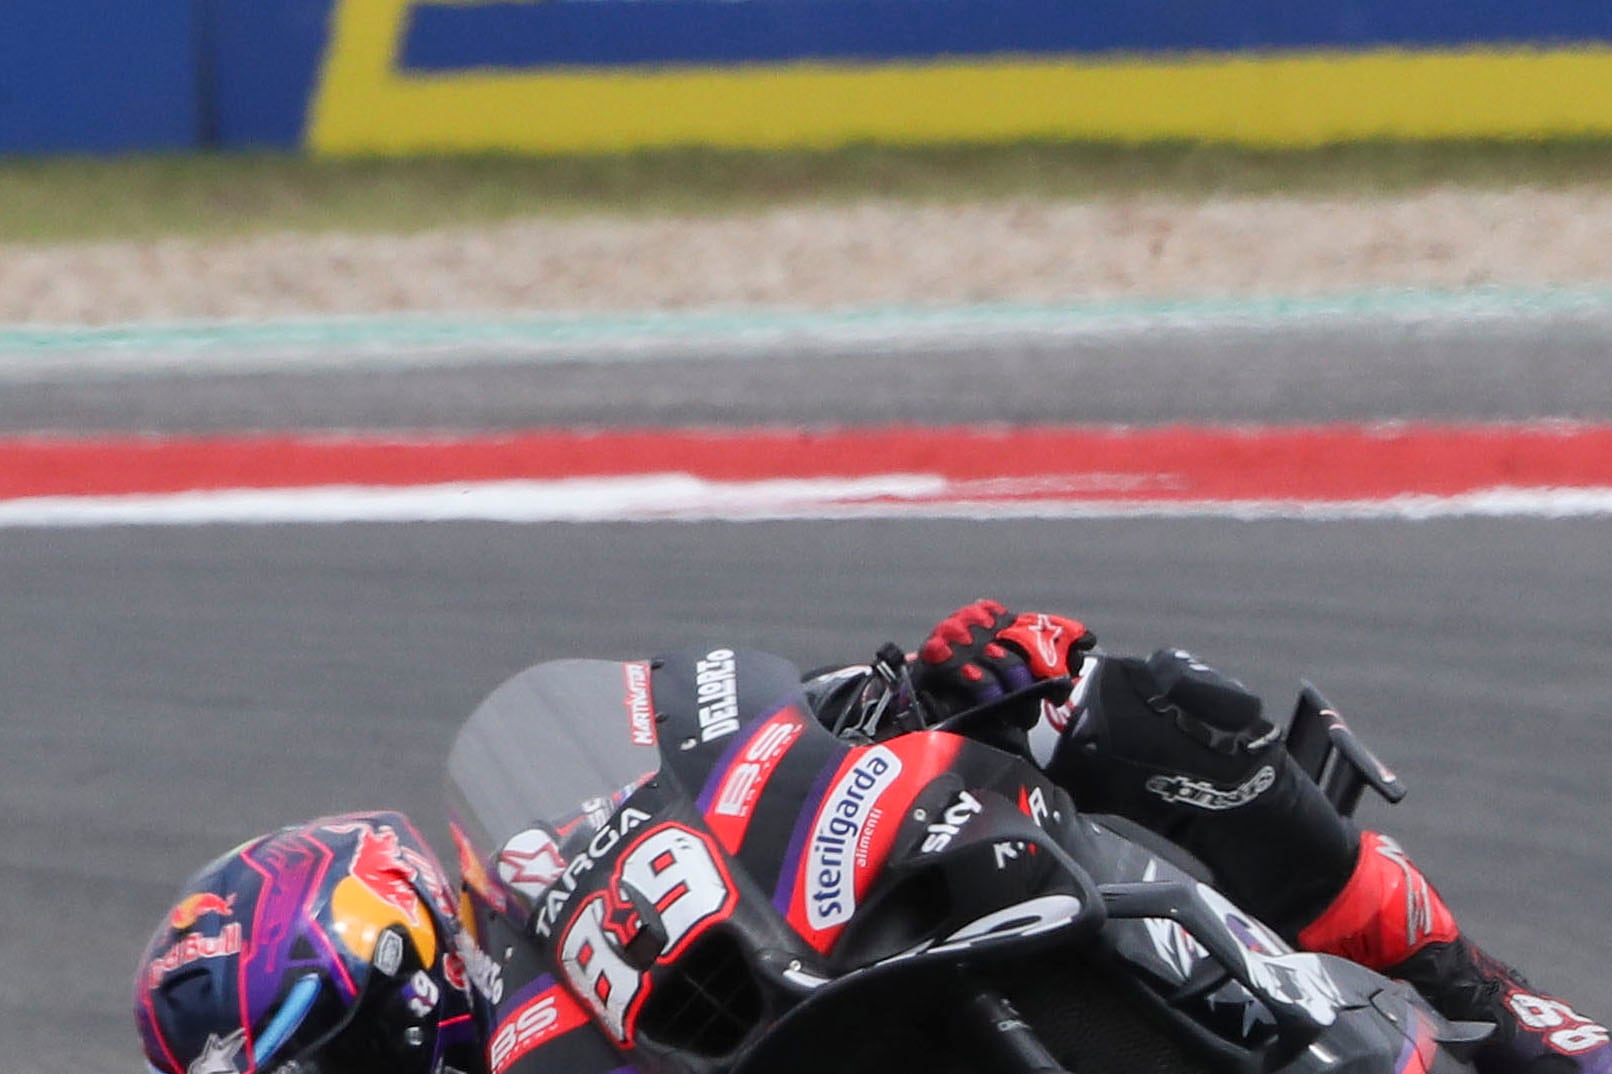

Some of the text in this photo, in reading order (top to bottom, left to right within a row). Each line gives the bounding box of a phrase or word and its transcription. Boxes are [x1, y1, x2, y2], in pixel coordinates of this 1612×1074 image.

[714, 722, 794, 816] BS
[813, 756, 889, 918] sterilgarda
[856, 807, 883, 868] alimenti
[920, 790, 983, 853] sky
[536, 807, 653, 938] TARGA
[558, 821, 739, 1048] 89
[490, 995, 558, 1070] BS
